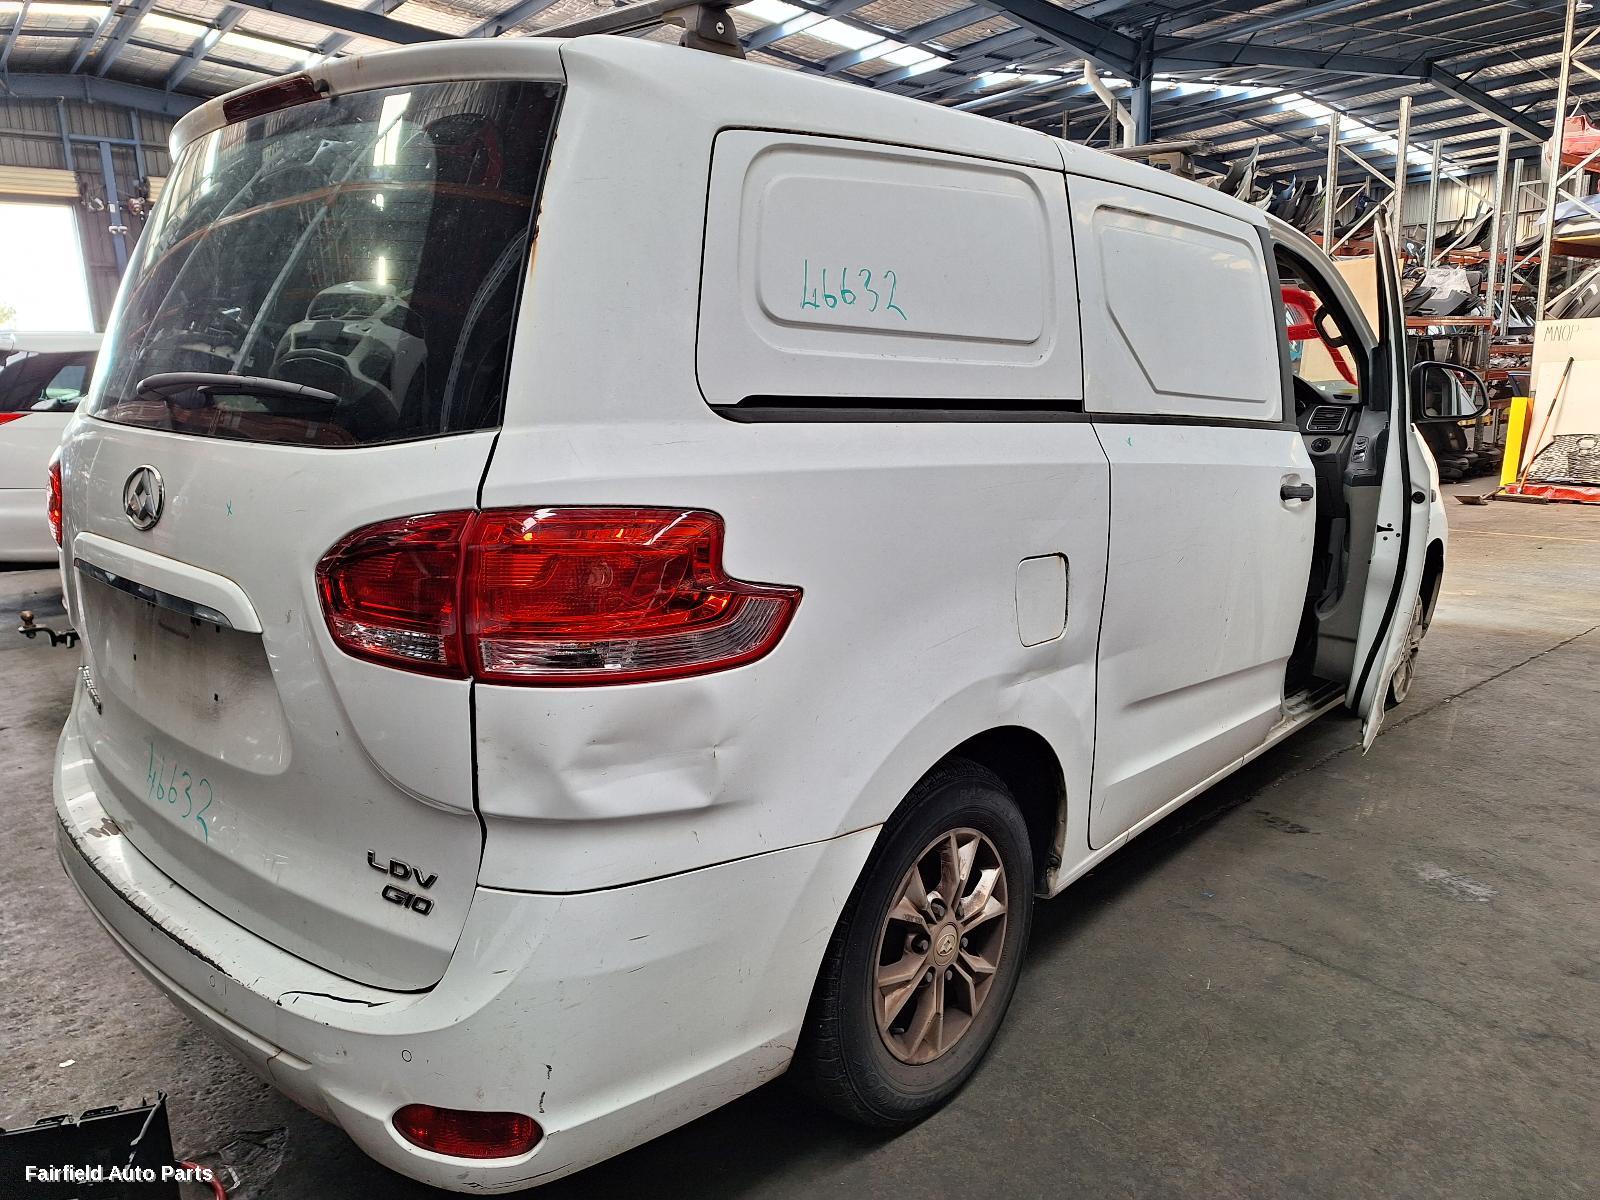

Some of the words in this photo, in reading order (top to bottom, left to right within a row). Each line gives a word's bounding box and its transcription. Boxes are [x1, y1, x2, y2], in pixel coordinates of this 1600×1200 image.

[800, 258, 908, 321] 46632
[147, 741, 213, 844] 46632
[367, 849, 438, 889] LDV
[381, 884, 435, 916] G10
